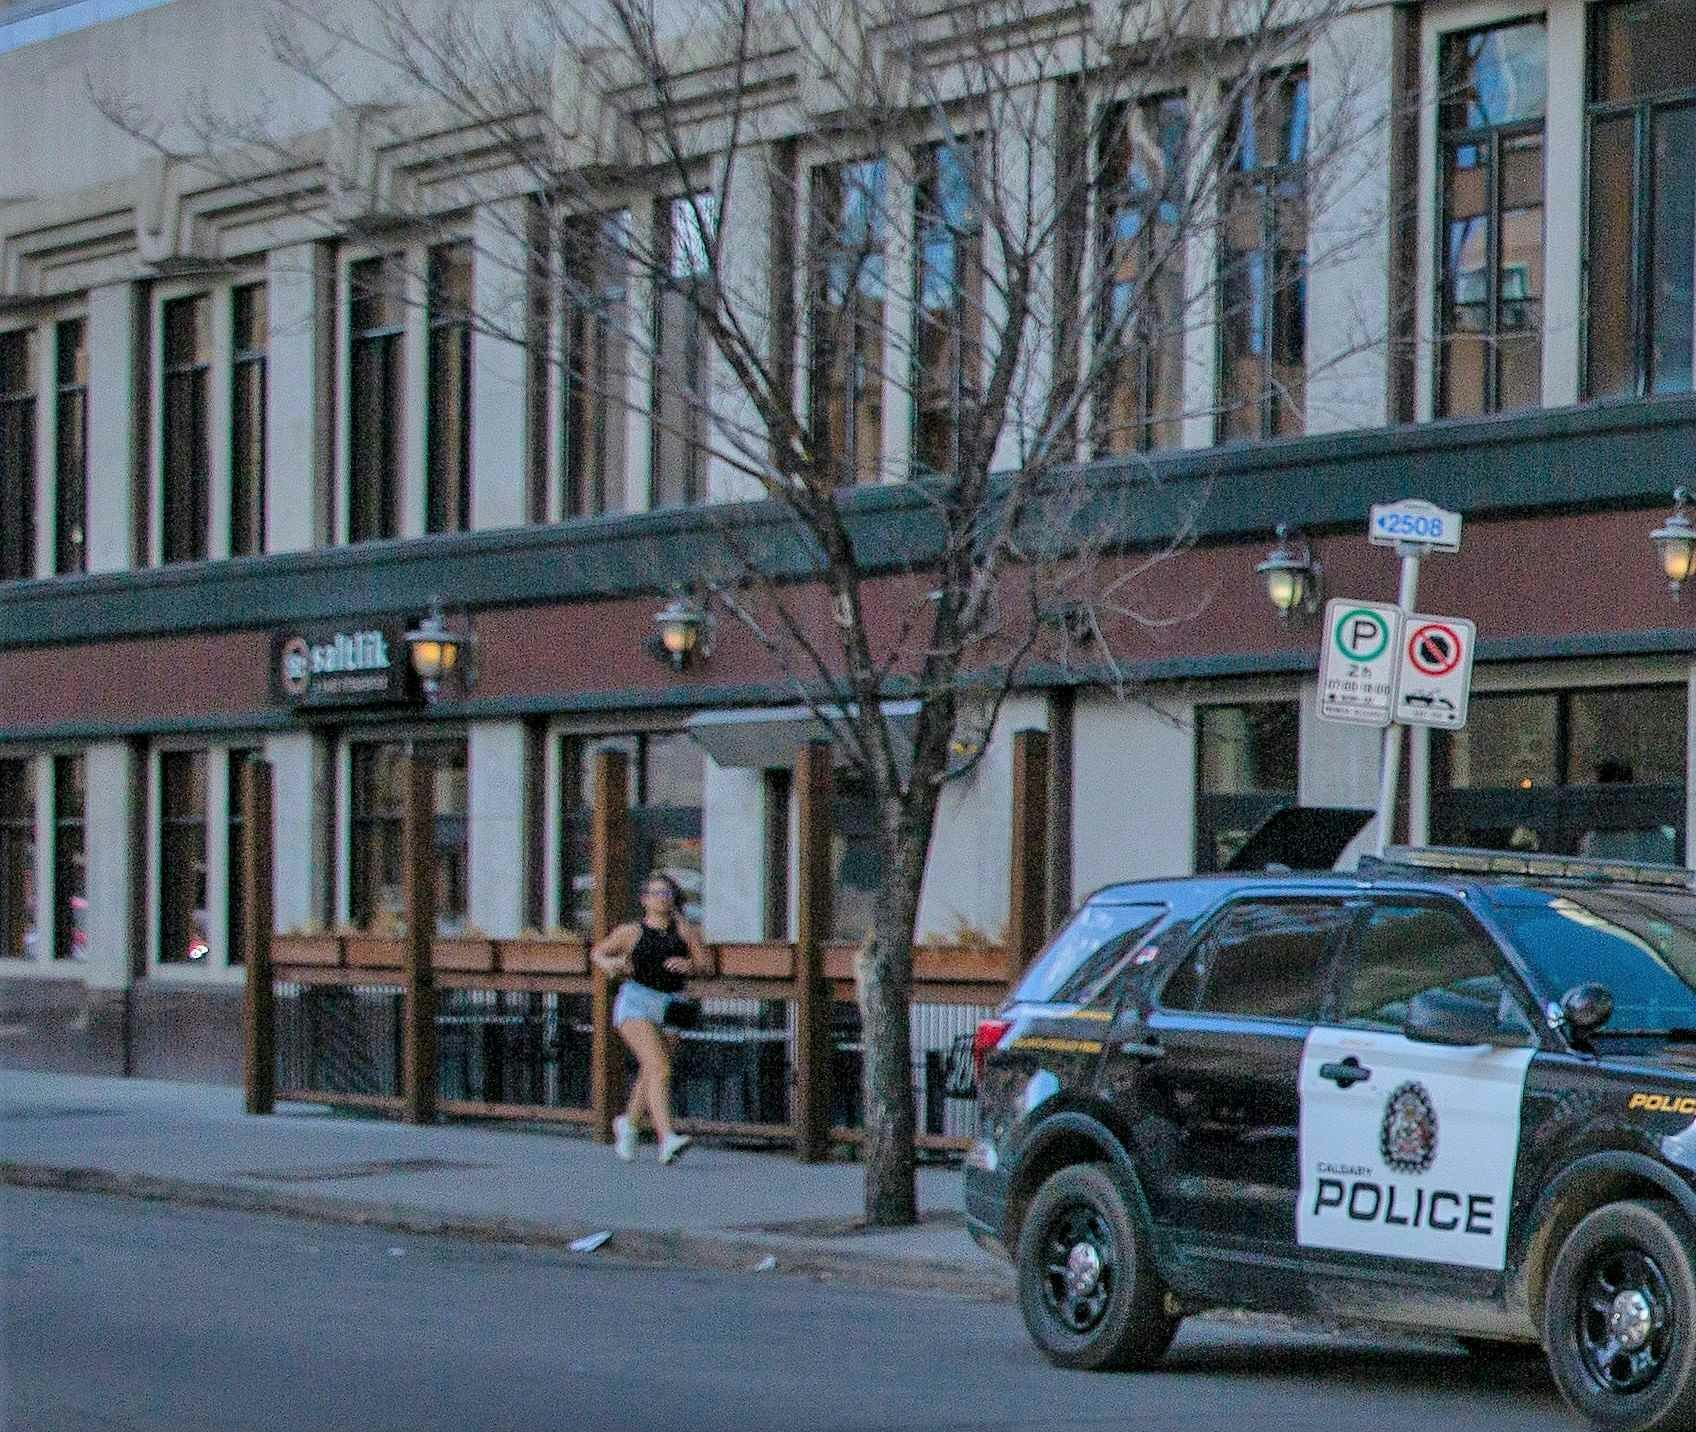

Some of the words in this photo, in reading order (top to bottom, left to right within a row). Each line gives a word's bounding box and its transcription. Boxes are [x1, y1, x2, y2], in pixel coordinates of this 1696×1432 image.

[1386, 513, 1444, 537] 2508
[311, 629, 391, 674] saltlik
[1352, 620, 1378, 649] P
[1313, 1177, 1496, 1236] POLICE
